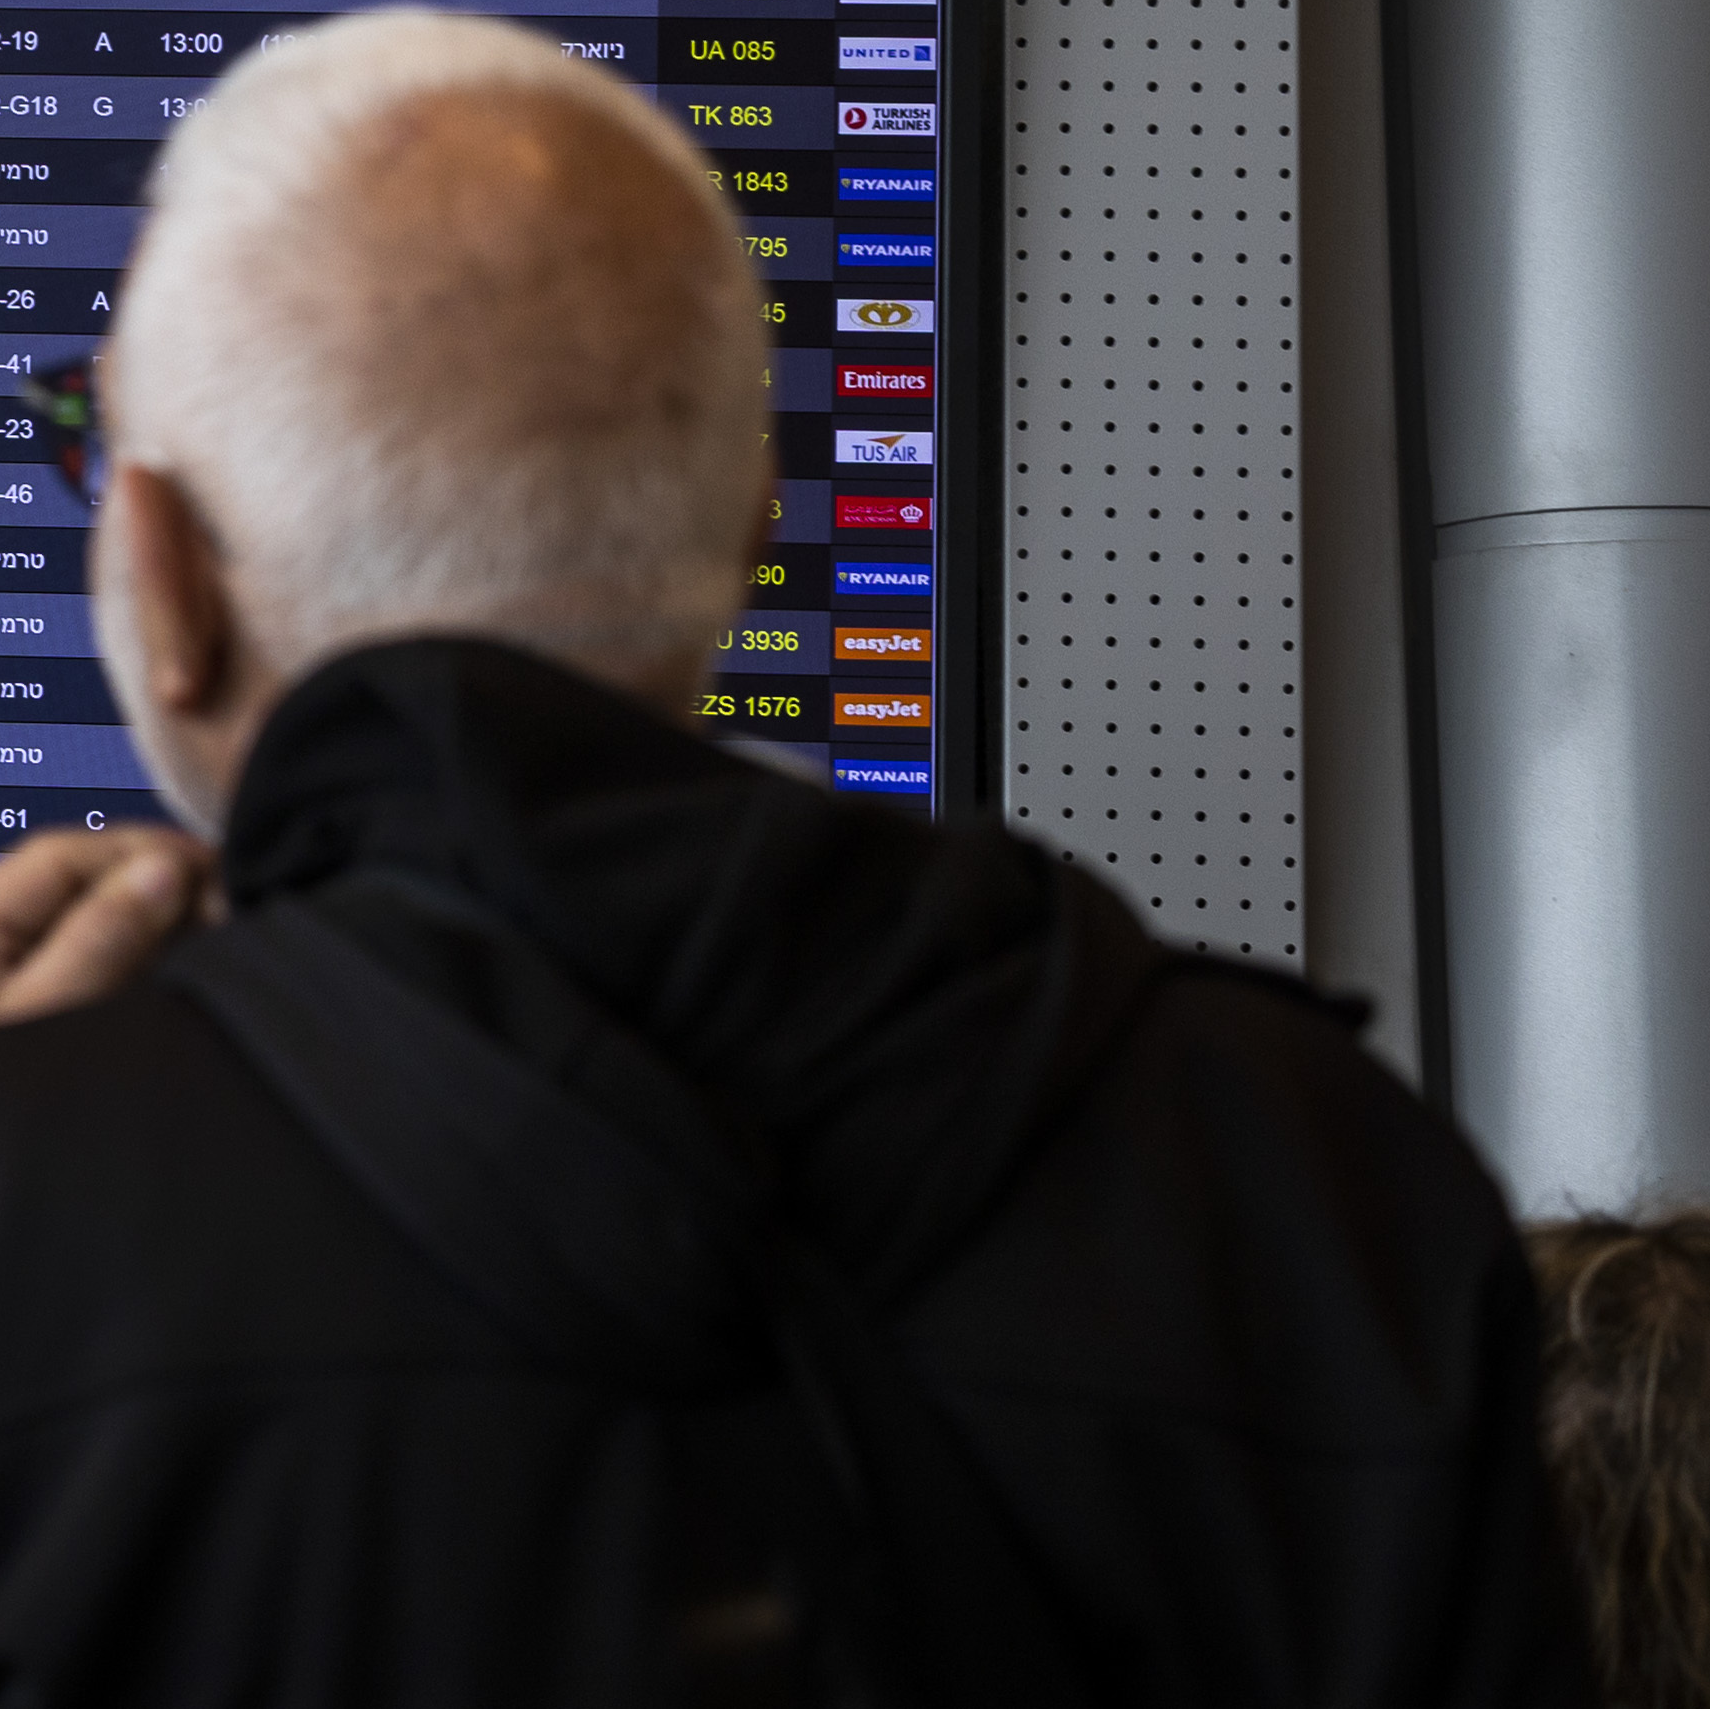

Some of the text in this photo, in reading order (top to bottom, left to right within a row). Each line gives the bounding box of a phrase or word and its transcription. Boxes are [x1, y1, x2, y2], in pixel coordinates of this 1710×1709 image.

[94, 31, 114, 53] A
[160, 32, 223, 54] 13:00
[690, 39, 776, 62] UA 085
[842, 48, 910, 58] UNITED
[872, 108, 931, 119] TURKISH
[872, 120, 931, 131] AIRLINES
[852, 445, 917, 462] TUS AIR
[844, 634, 922, 653] easyJet
[85, 810, 105, 831] C
